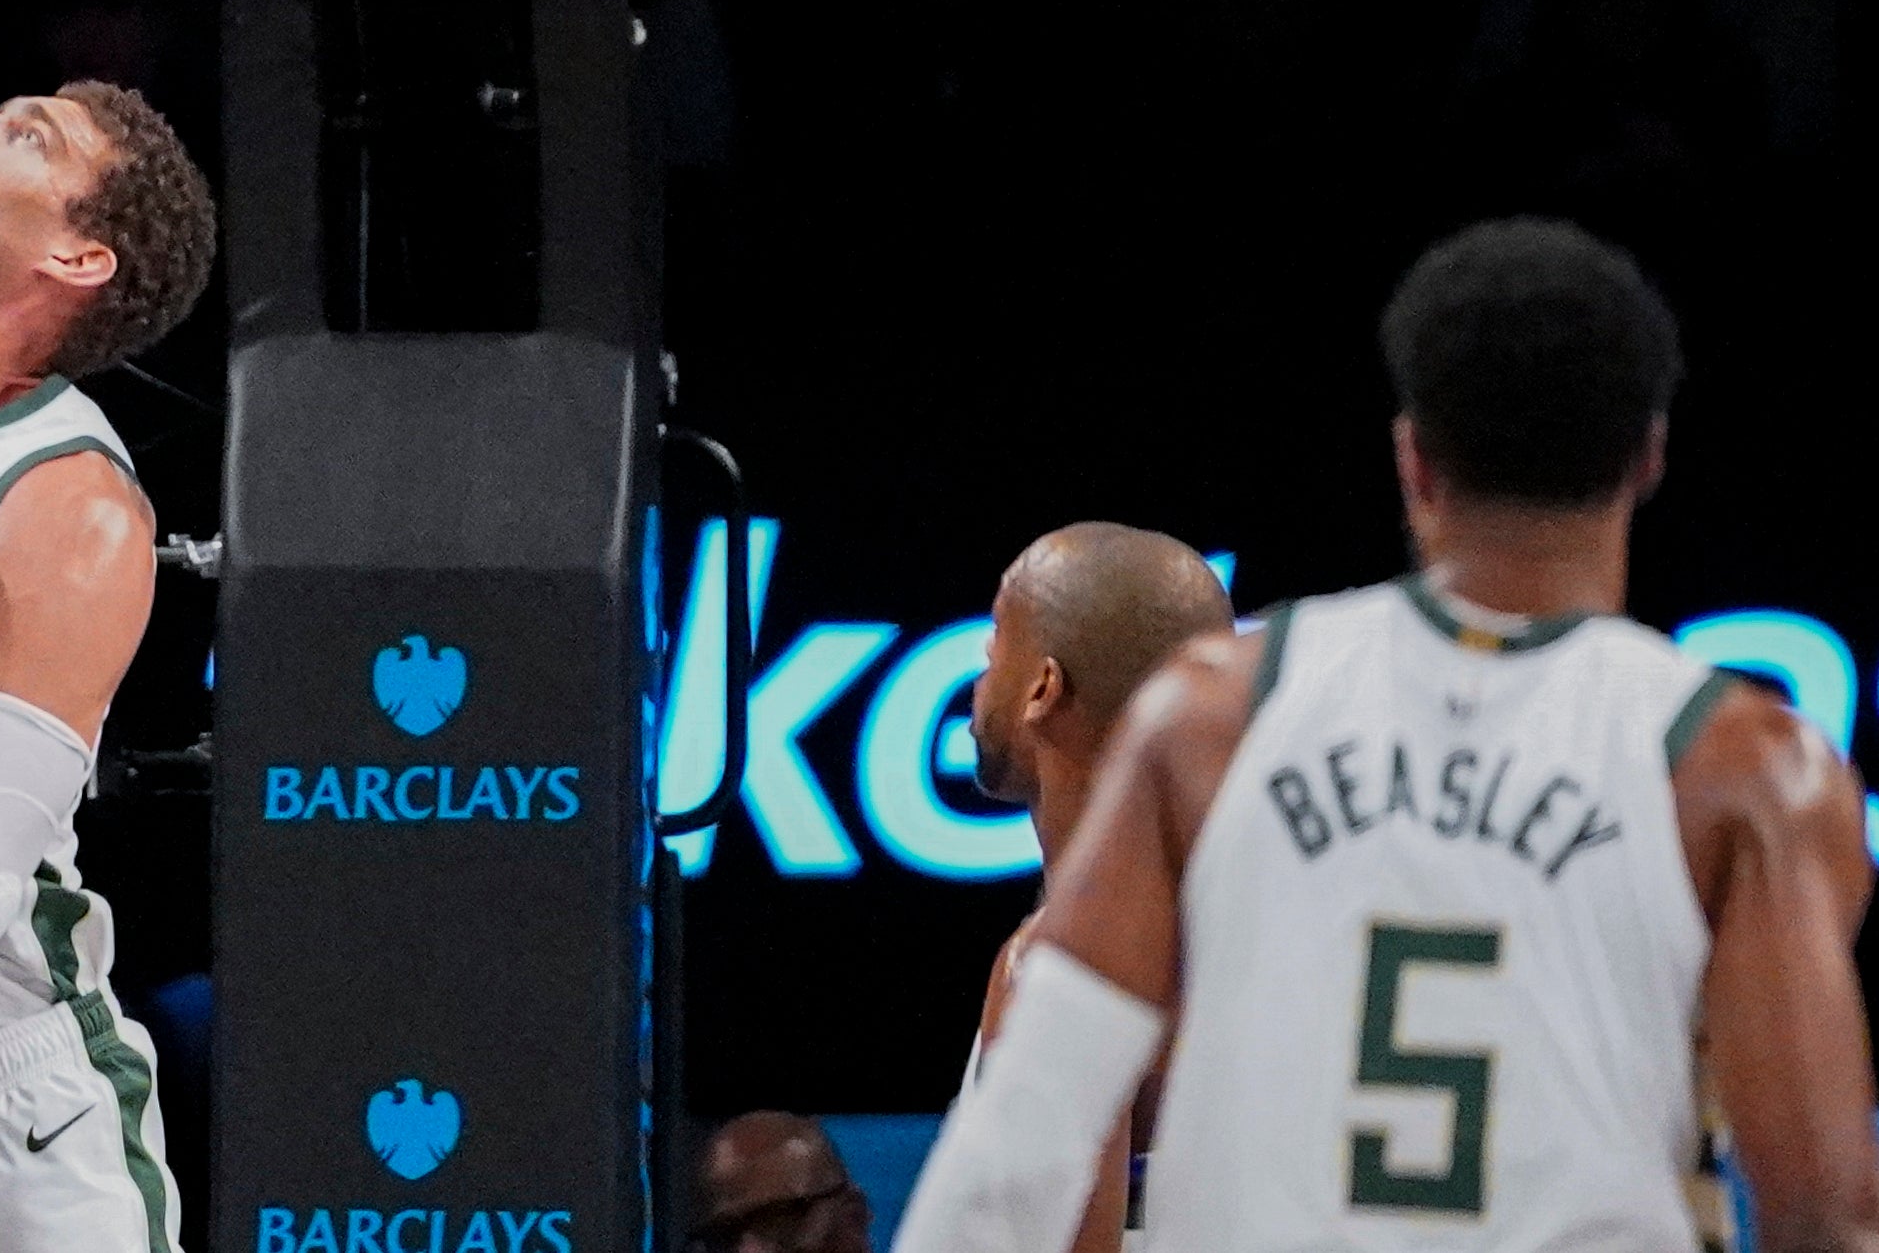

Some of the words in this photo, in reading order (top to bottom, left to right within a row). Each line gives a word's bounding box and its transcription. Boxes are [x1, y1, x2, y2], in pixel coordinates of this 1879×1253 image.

[263, 765, 583, 823] BARCLAYS
[1267, 738, 1623, 886] BEASLEY
[1348, 919, 1507, 1219] 5
[257, 1205, 575, 1253] BARCLAYS
